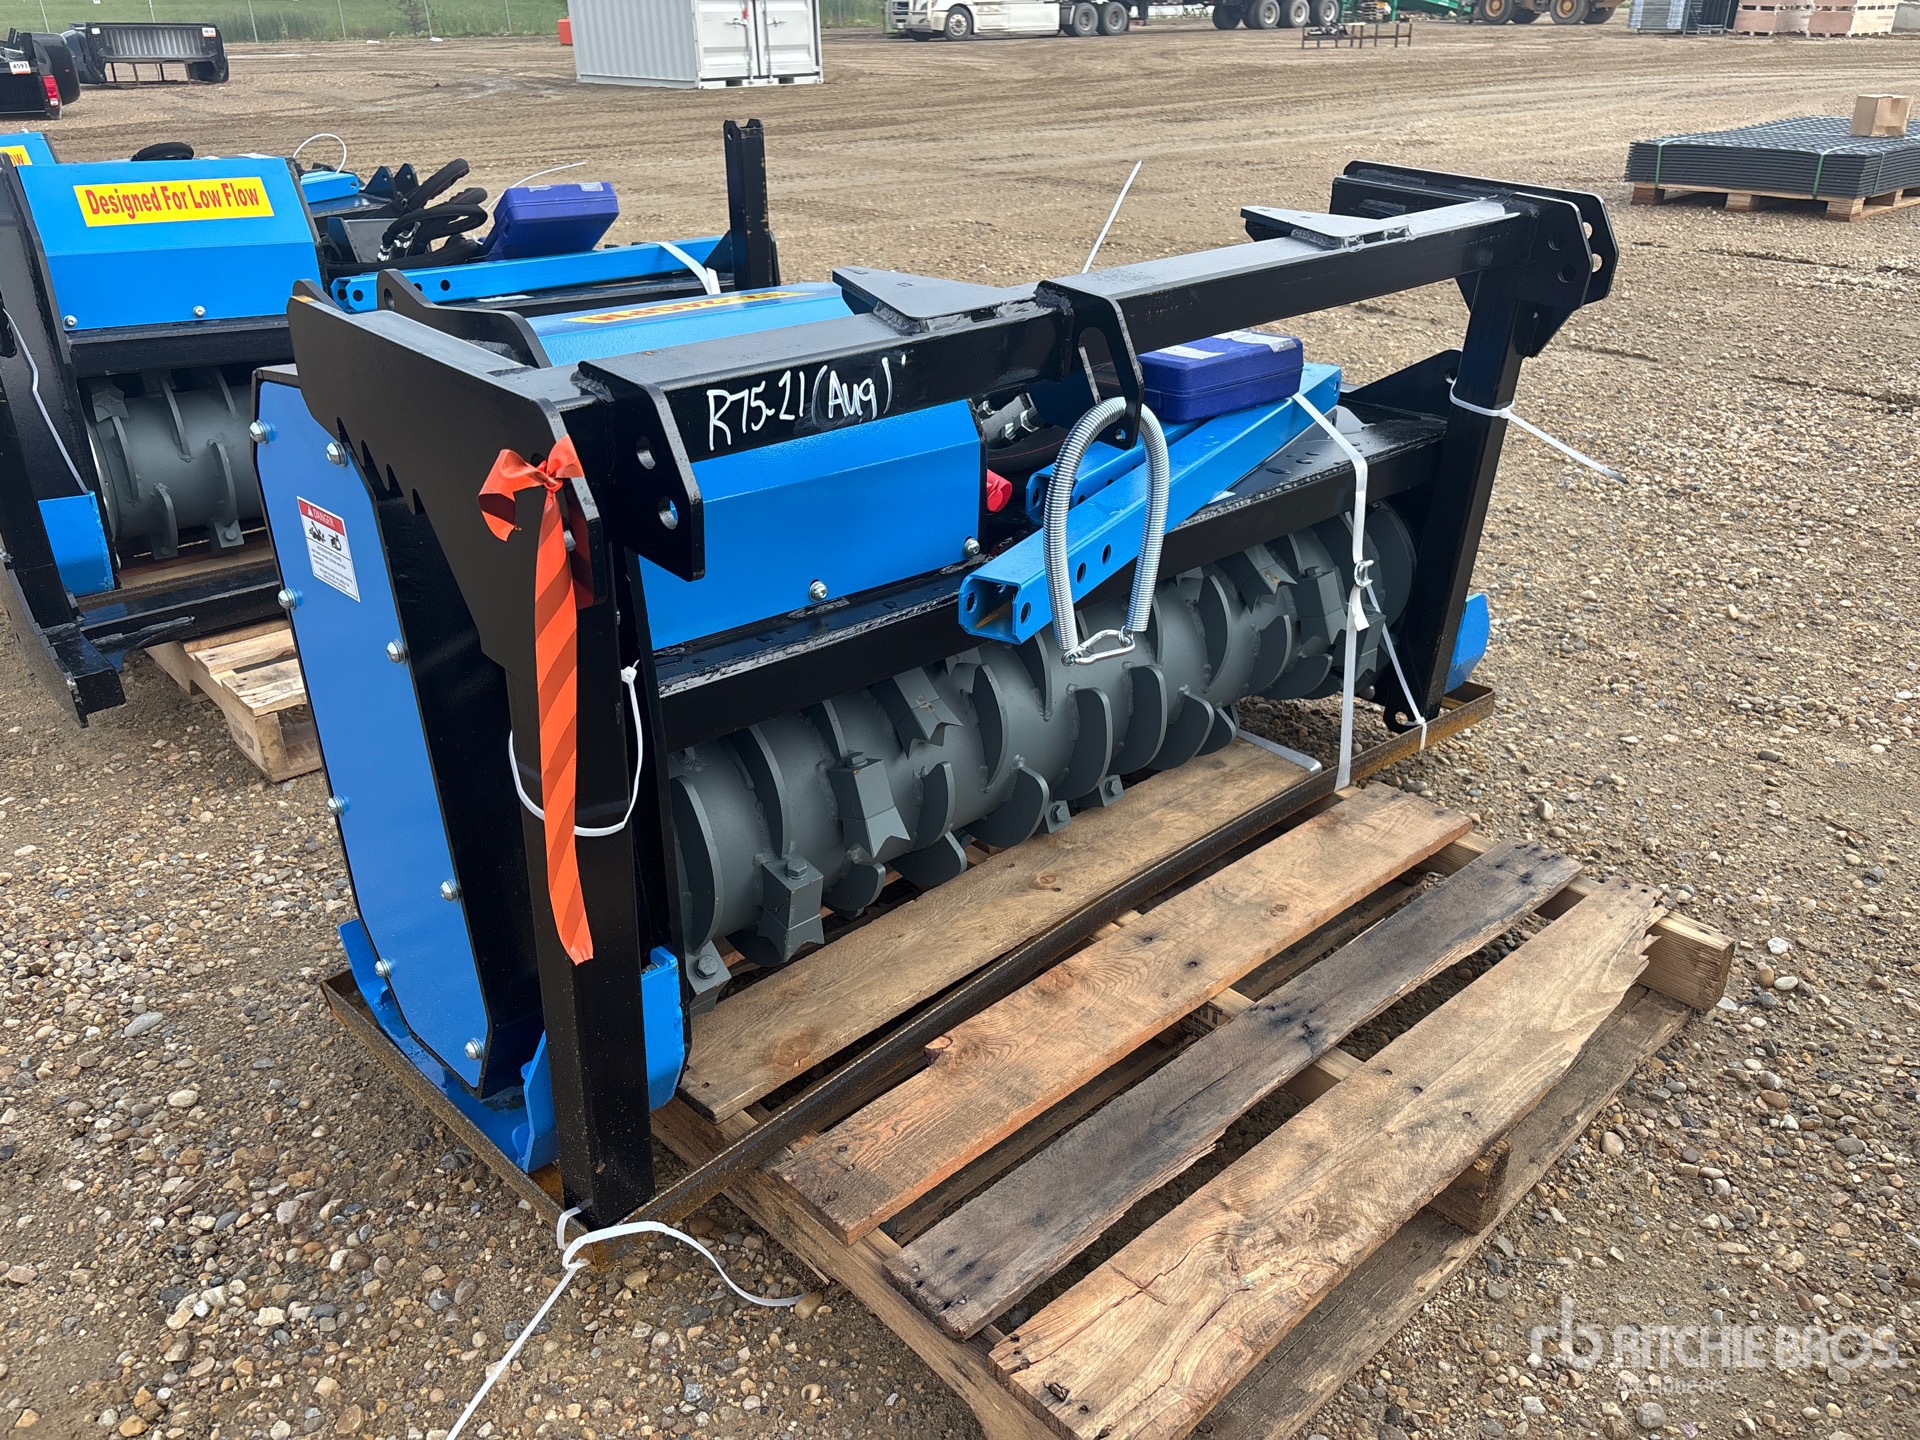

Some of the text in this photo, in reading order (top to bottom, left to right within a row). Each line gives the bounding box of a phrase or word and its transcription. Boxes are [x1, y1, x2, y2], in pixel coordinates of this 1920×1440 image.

[85, 182, 259, 220] Designed For Low Flow
[312, 507, 335, 528] DANGER
